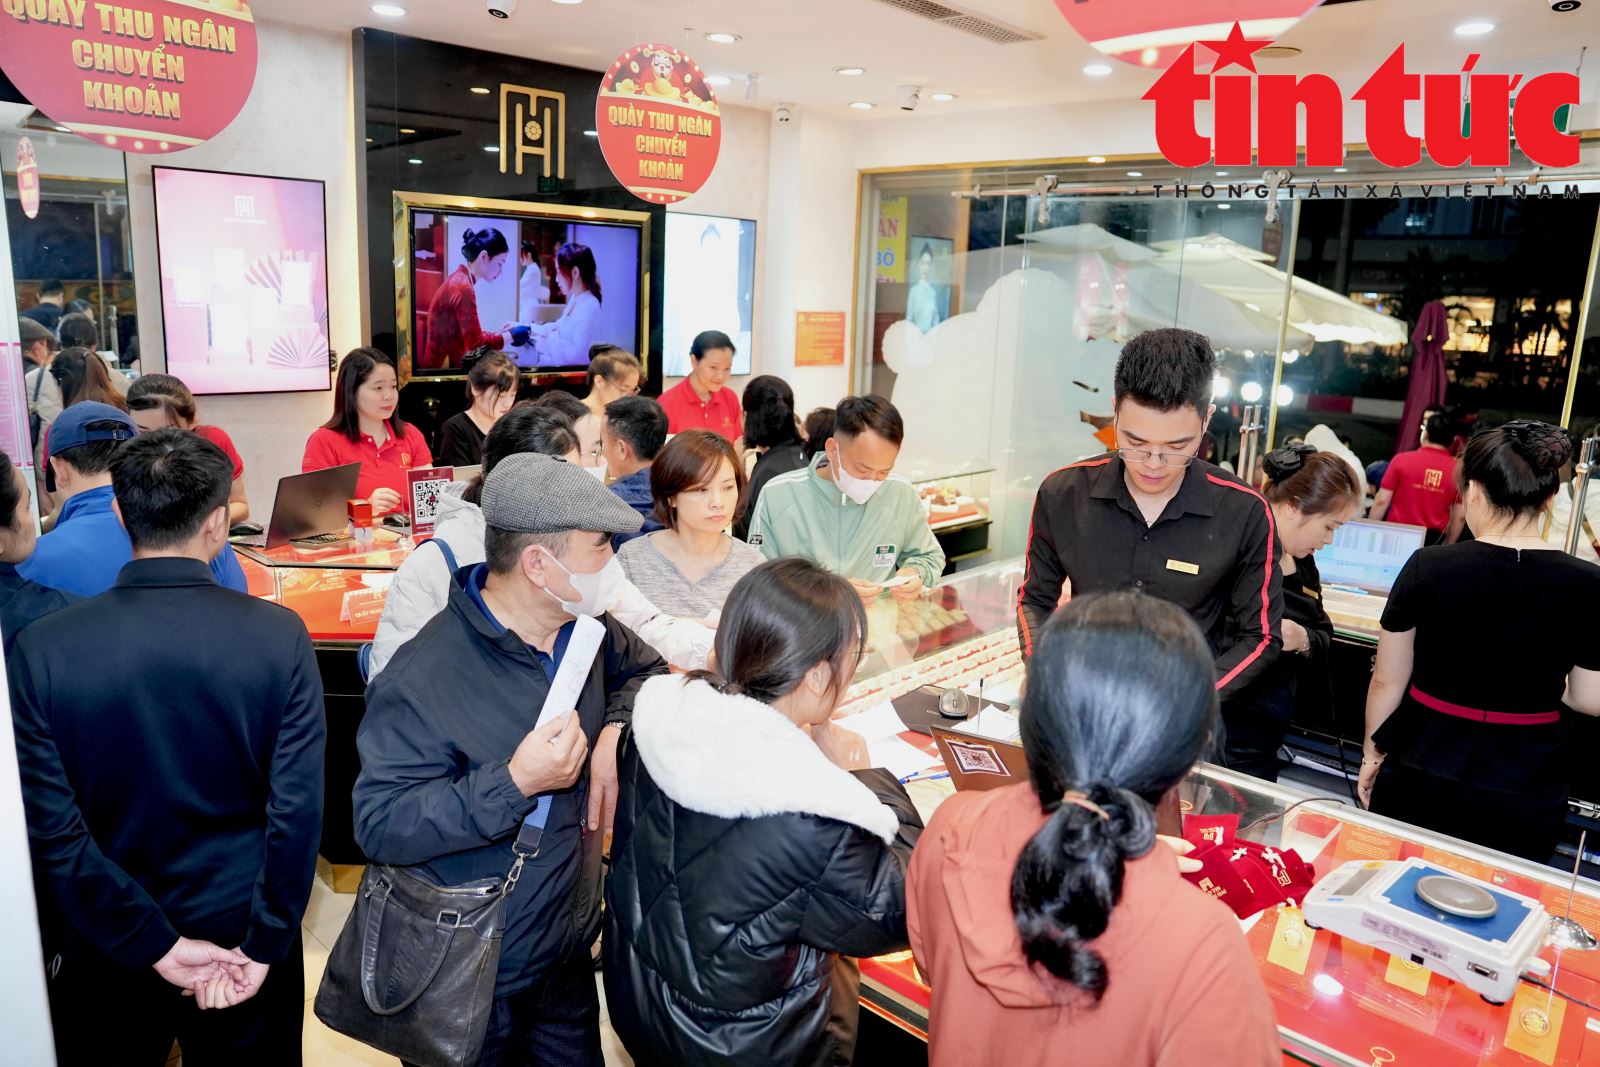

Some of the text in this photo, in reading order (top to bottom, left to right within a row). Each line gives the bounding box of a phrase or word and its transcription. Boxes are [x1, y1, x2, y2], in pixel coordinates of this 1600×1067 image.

[95, 3, 154, 39] THU
[163, 16, 236, 53] NGÂN
[71, 39, 185, 82] CHUYỂN
[83, 79, 181, 119] KHOẢN
[608, 103, 712, 137] QUẦY THU NGÂN
[635, 133, 687, 157] CHUYỂN
[639, 158, 683, 181] KHOẢN
